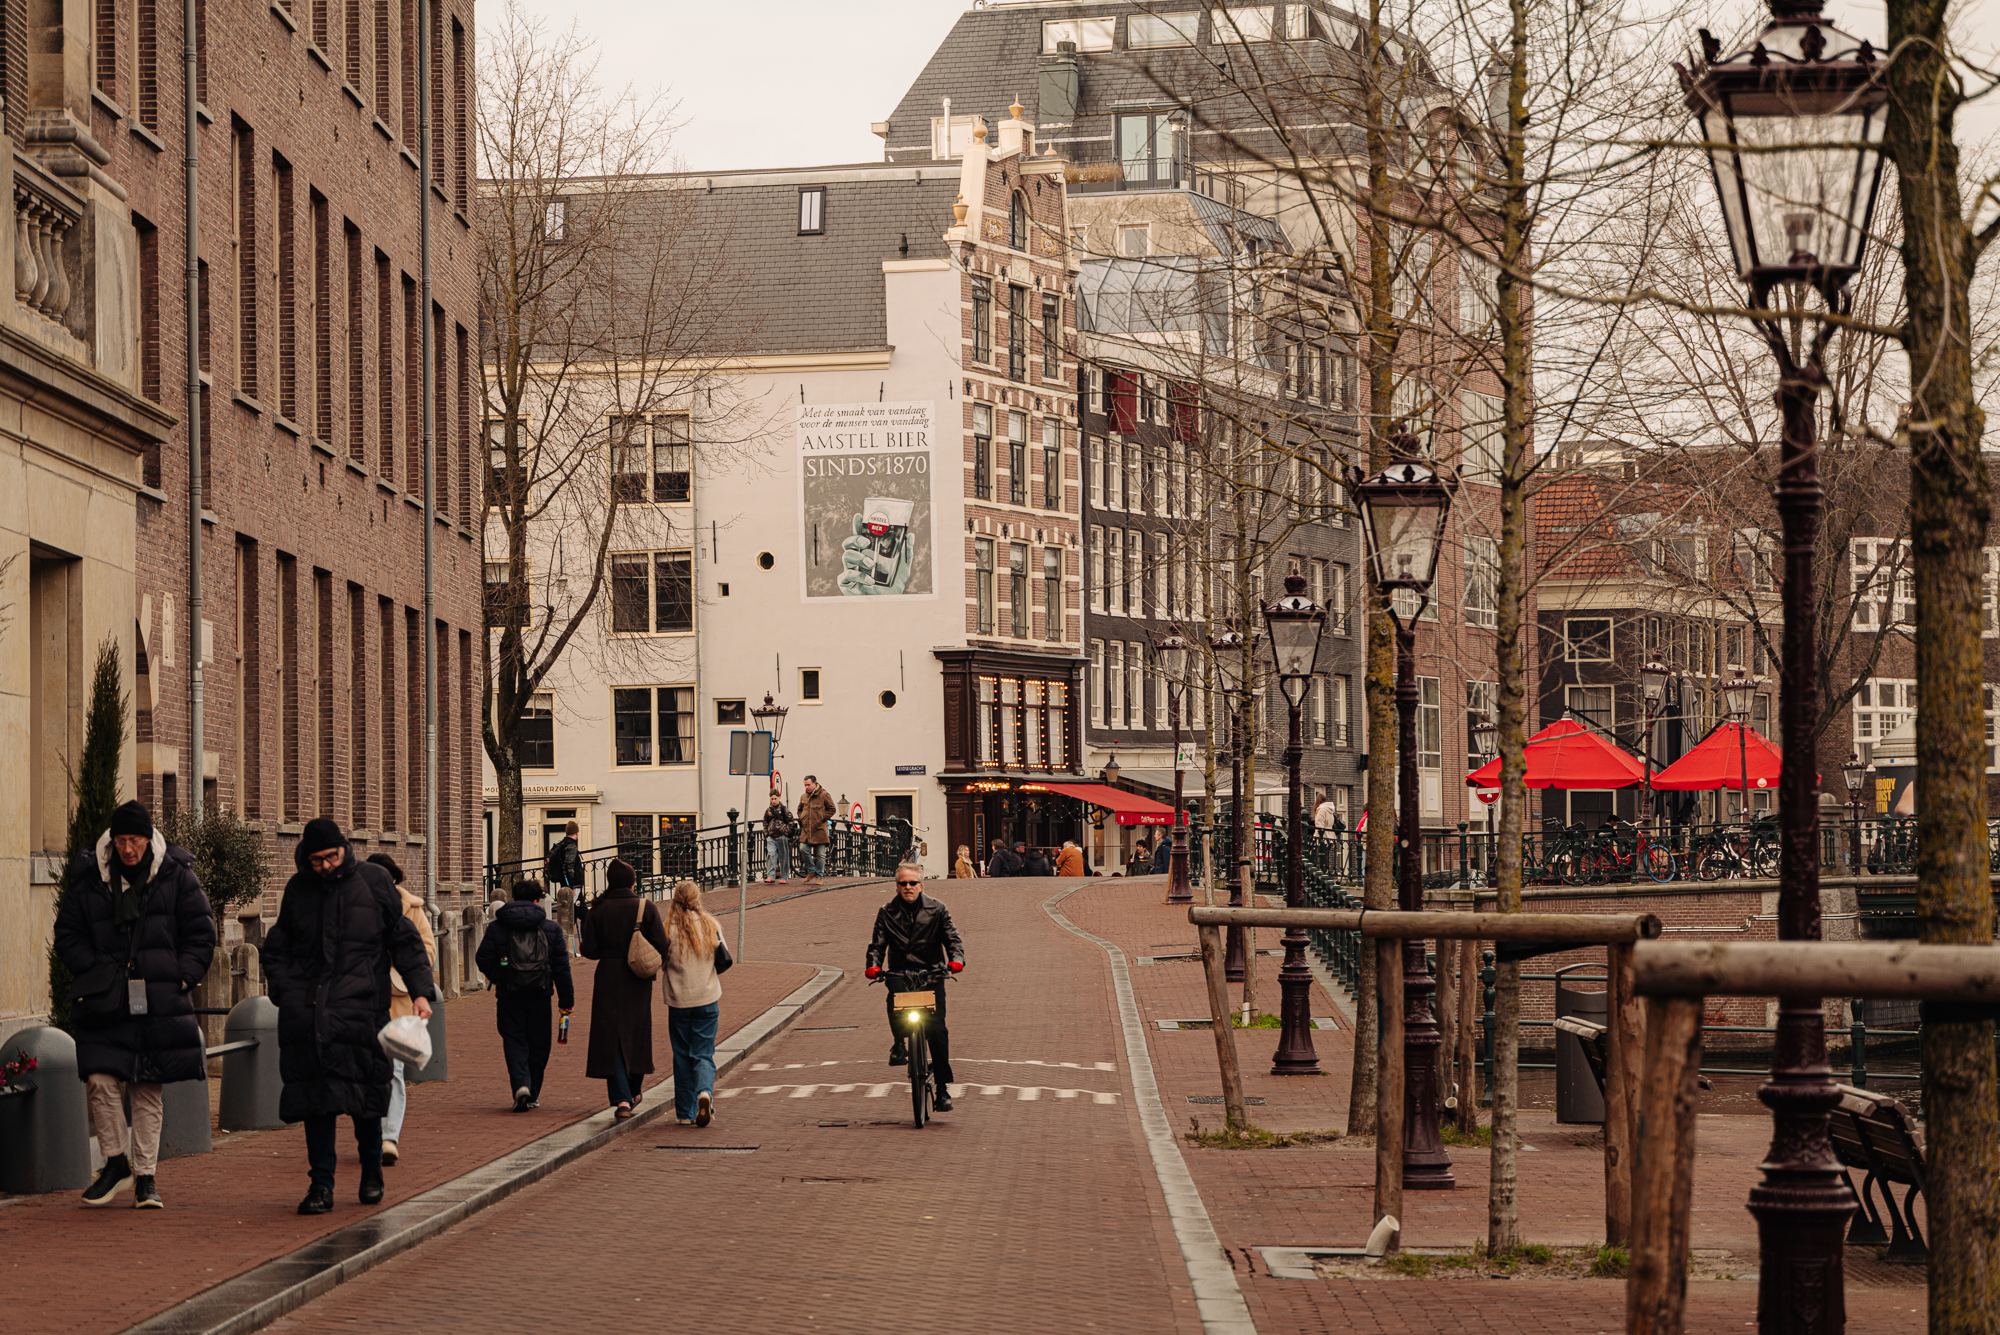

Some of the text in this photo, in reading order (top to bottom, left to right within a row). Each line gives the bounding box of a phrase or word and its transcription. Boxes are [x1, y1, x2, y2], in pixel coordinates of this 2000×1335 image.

[802, 407, 821, 418] Met
[824, 408, 834, 417] de
[837, 407, 865, 417] smaak
[888, 406, 927, 418] vandaag
[822, 419, 833, 428] de
[835, 420, 868, 428] mensen
[871, 419, 888, 427] van
[891, 416, 929, 428] vandaag
[802, 431, 929, 450] AMSTEL BIER
[806, 455, 927, 477] SINDS 1870
[523, 785, 586, 793] HAARVERZORGING
